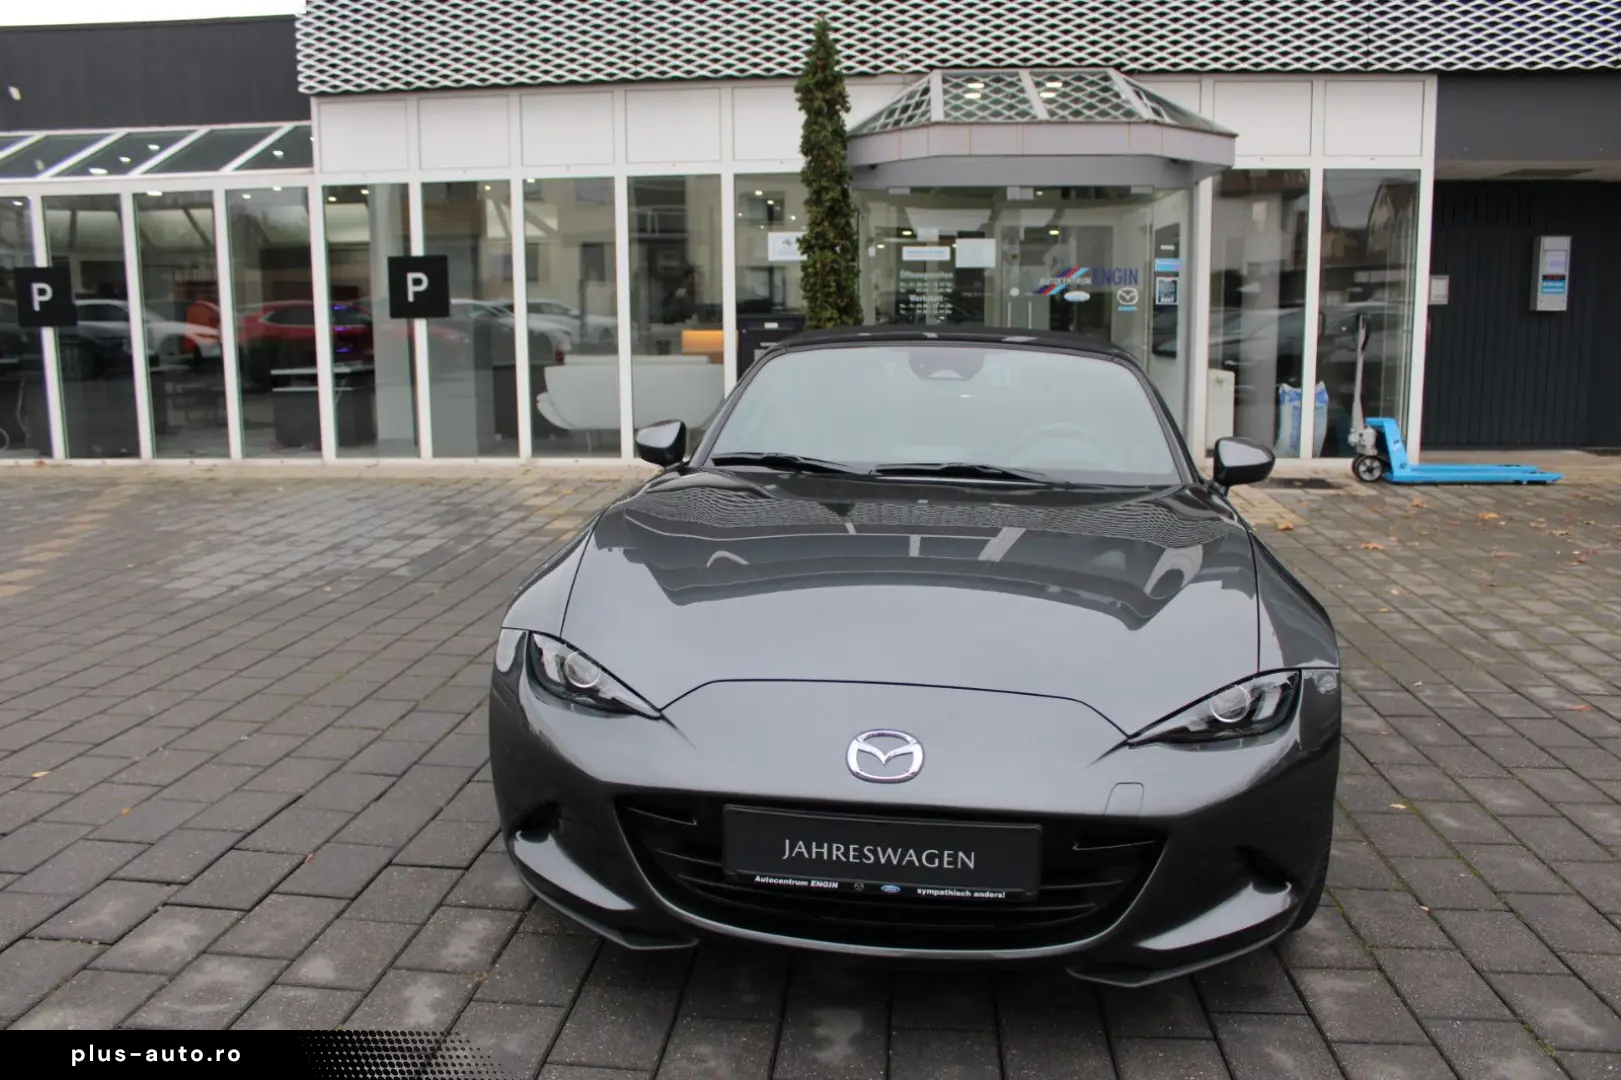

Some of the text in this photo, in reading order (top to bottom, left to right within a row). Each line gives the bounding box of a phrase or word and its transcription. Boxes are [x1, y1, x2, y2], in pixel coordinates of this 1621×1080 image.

[406, 271, 430, 304] P
[1092, 267, 1139, 286] ENGIN
[31, 282, 53, 312] P
[781, 839, 976, 870] JAHRESWAGEN
[754, 875, 839, 889] Autocentrum ENGIN
[917, 887, 1006, 899] sympathisch anders!
